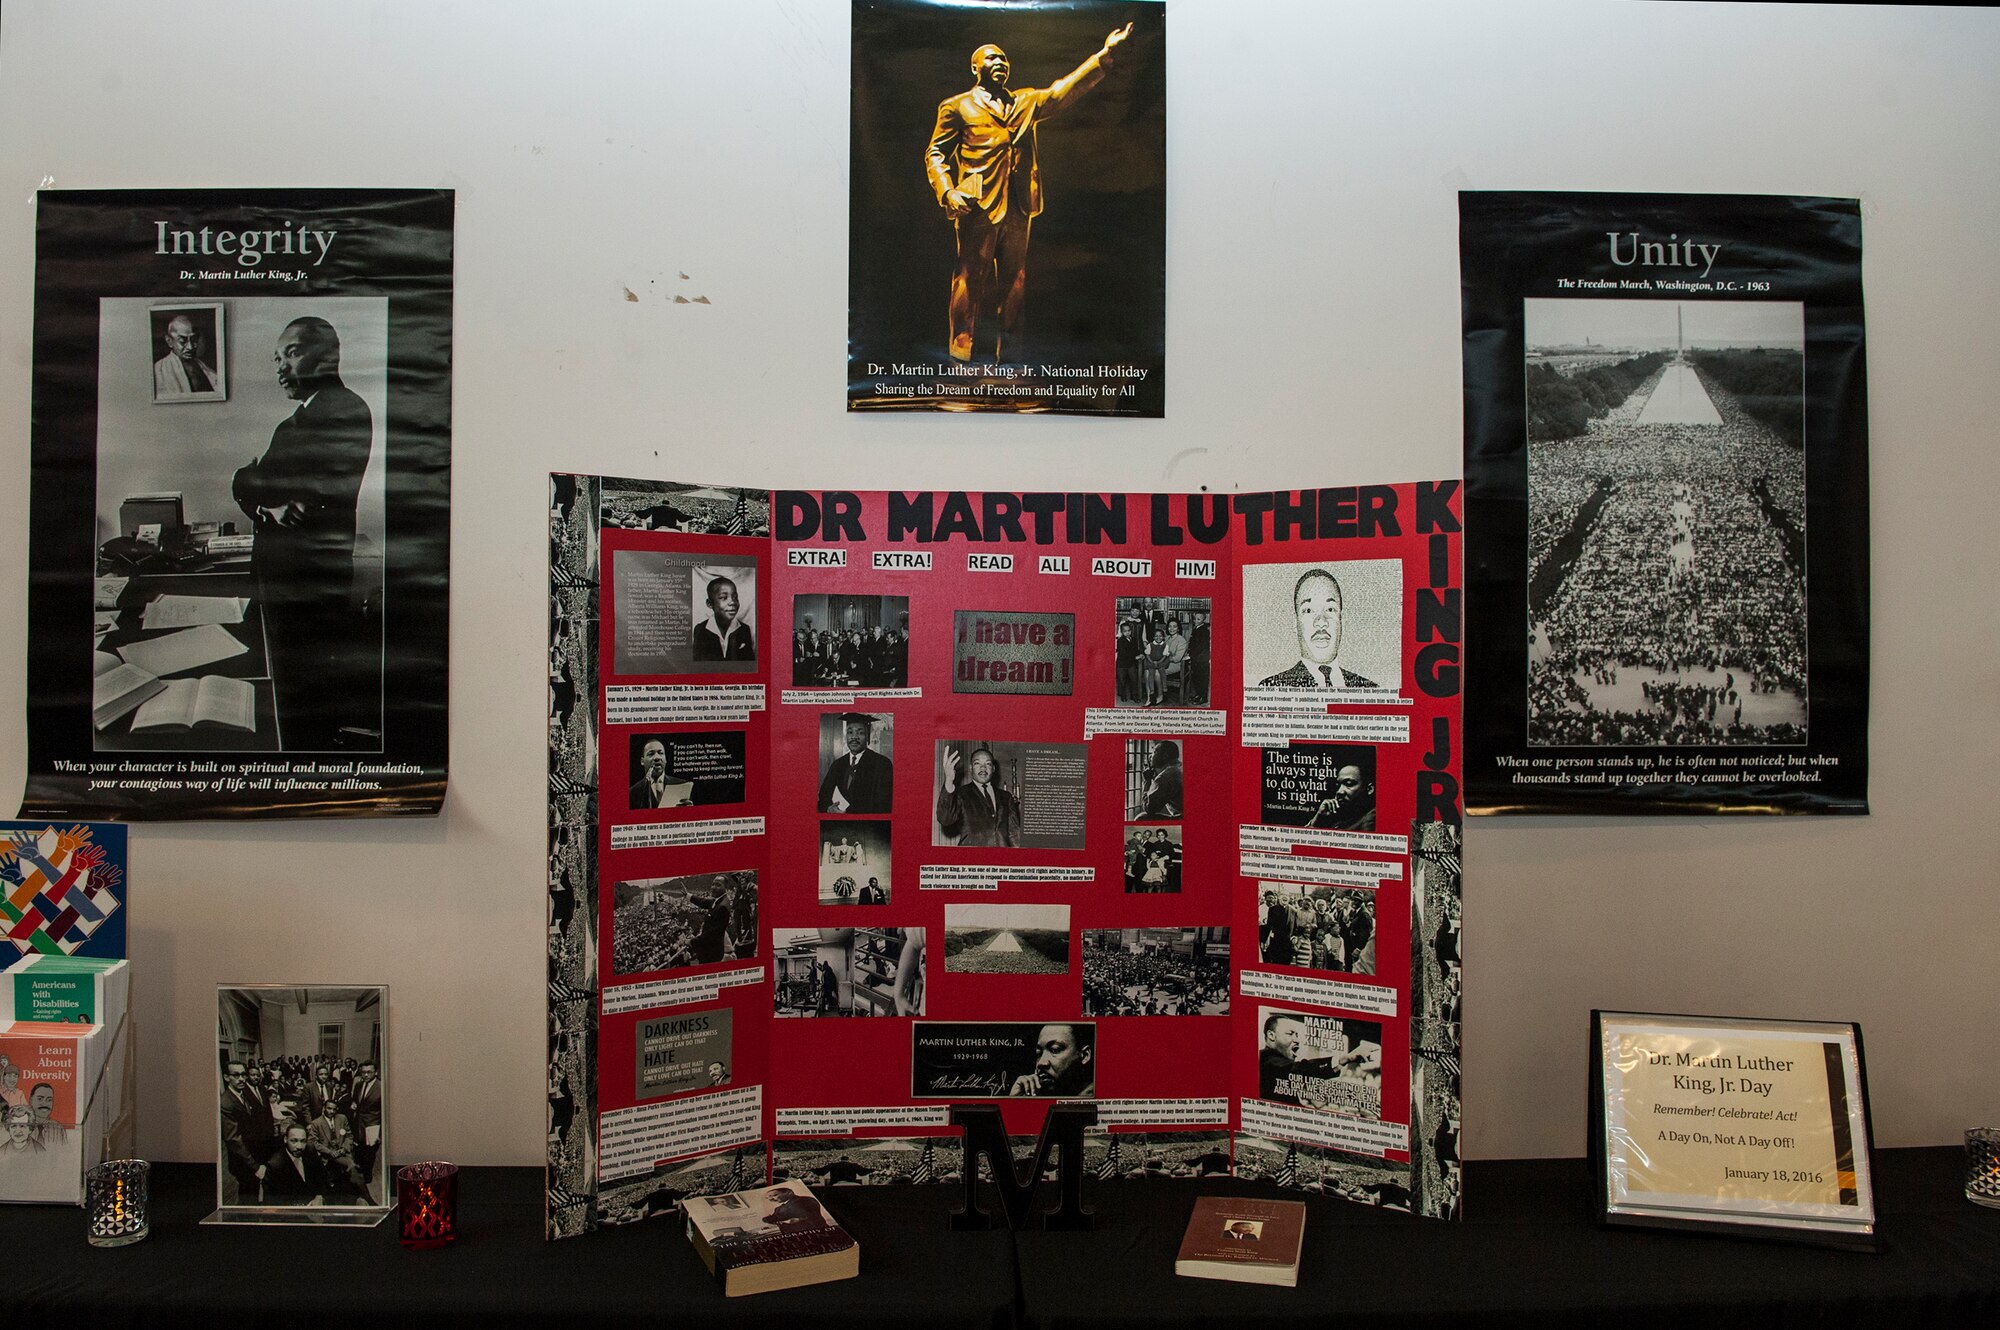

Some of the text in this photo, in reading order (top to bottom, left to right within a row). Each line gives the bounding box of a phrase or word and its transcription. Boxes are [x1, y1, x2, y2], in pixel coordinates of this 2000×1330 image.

[154, 221, 337, 266] Integrity
[1606, 232, 1721, 278] Unity
[180, 270, 307, 281] Dr. Martin Luther King, Jr.
[1557, 279, 1575, 288] The
[1578, 279, 1617, 288] Freedom
[1620, 280, 1652, 290] March,
[1656, 280, 1713, 292] Washington,
[1716, 282, 1737, 290] D.C.
[1748, 282, 1770, 291] 1963
[868, 363, 1147, 380] Dr. Martin Luther King, Jr. National Holiday
[875, 383, 1135, 399] Sharing the Dream of Freedom and Equality for All
[775, 485, 1402, 545] DR MARTIN LUTHER
[664, 558, 706, 567] Childhood
[788, 551, 1216, 576] EXTRA! EXTRA! READ ALL ABOUT HIM!
[1414, 480, 1462, 698] KING
[976, 617, 1046, 645] have
[1053, 623, 1070, 646] a
[958, 656, 1054, 683] dream
[1267, 751, 1332, 765] The time is
[1496, 756, 1528, 766] When
[1556, 759, 1593, 770] person
[1597, 755, 1633, 766] stands
[1638, 759, 1654, 769] up,
[1659, 755, 1672, 766] he
[1675, 756, 1684, 766] is
[1688, 755, 1716, 769] often
[1720, 757, 1737, 765] not
[1741, 754, 1785, 767] noticed;
[1788, 754, 1806, 765] but
[1810, 754, 1838, 765] when
[54, 760, 86, 771] When
[89, 764, 116, 774] your
[119, 760, 174, 772] character
[177, 762, 187, 772] is
[190, 761, 217, 772] built
[239, 761, 289, 775] spiritual
[293, 762, 315, 772] and
[319, 762, 353, 773] moral
[354, 762, 424, 776] foundation,
[1266, 763, 1338, 780] always right
[1416, 717, 1462, 827] JR
[88, 778, 382, 792] your contagious way of life will influence millions.
[1266, 777, 1327, 791] to do what
[1513, 771, 1821, 786] thousands stand up together they cannot be overlooked.
[1277, 787, 1321, 804] is right.
[32, 981, 76, 989] Americans
[33, 1000, 80, 1008] Disabilities
[645, 1017, 709, 1039] DARKNESS
[1304, 1016, 1344, 1031] MARTIN
[644, 1037, 665, 1046] CANNOT
[666, 1035, 680, 1043] DRIVE
[693, 1030, 718, 1039] DARKNESS
[1304, 1026, 1343, 1042] LUTHER
[39, 1045, 72, 1055] Learn
[919, 1038, 1025, 1047] MARTIN LUTHER KING, JR.
[1304, 1036, 1344, 1051] KING JR
[38, 1058, 72, 1068] About
[645, 1050, 675, 1067] HATE
[1650, 1051, 1671, 1065] Dr.
[1737, 1056, 1793, 1071] Luther
[23, 1070, 72, 1082] Diversity
[1674, 1075, 1772, 1097] King, Jr. Day
[1654, 1104, 1797, 1121] Remember! Celebrate! Act!
[1658, 1131, 1794, 1149] A Day On, Not A Day Off!
[950, 1103, 1098, 1231] M
[1725, 1167, 1822, 1183] January 18, 2016
